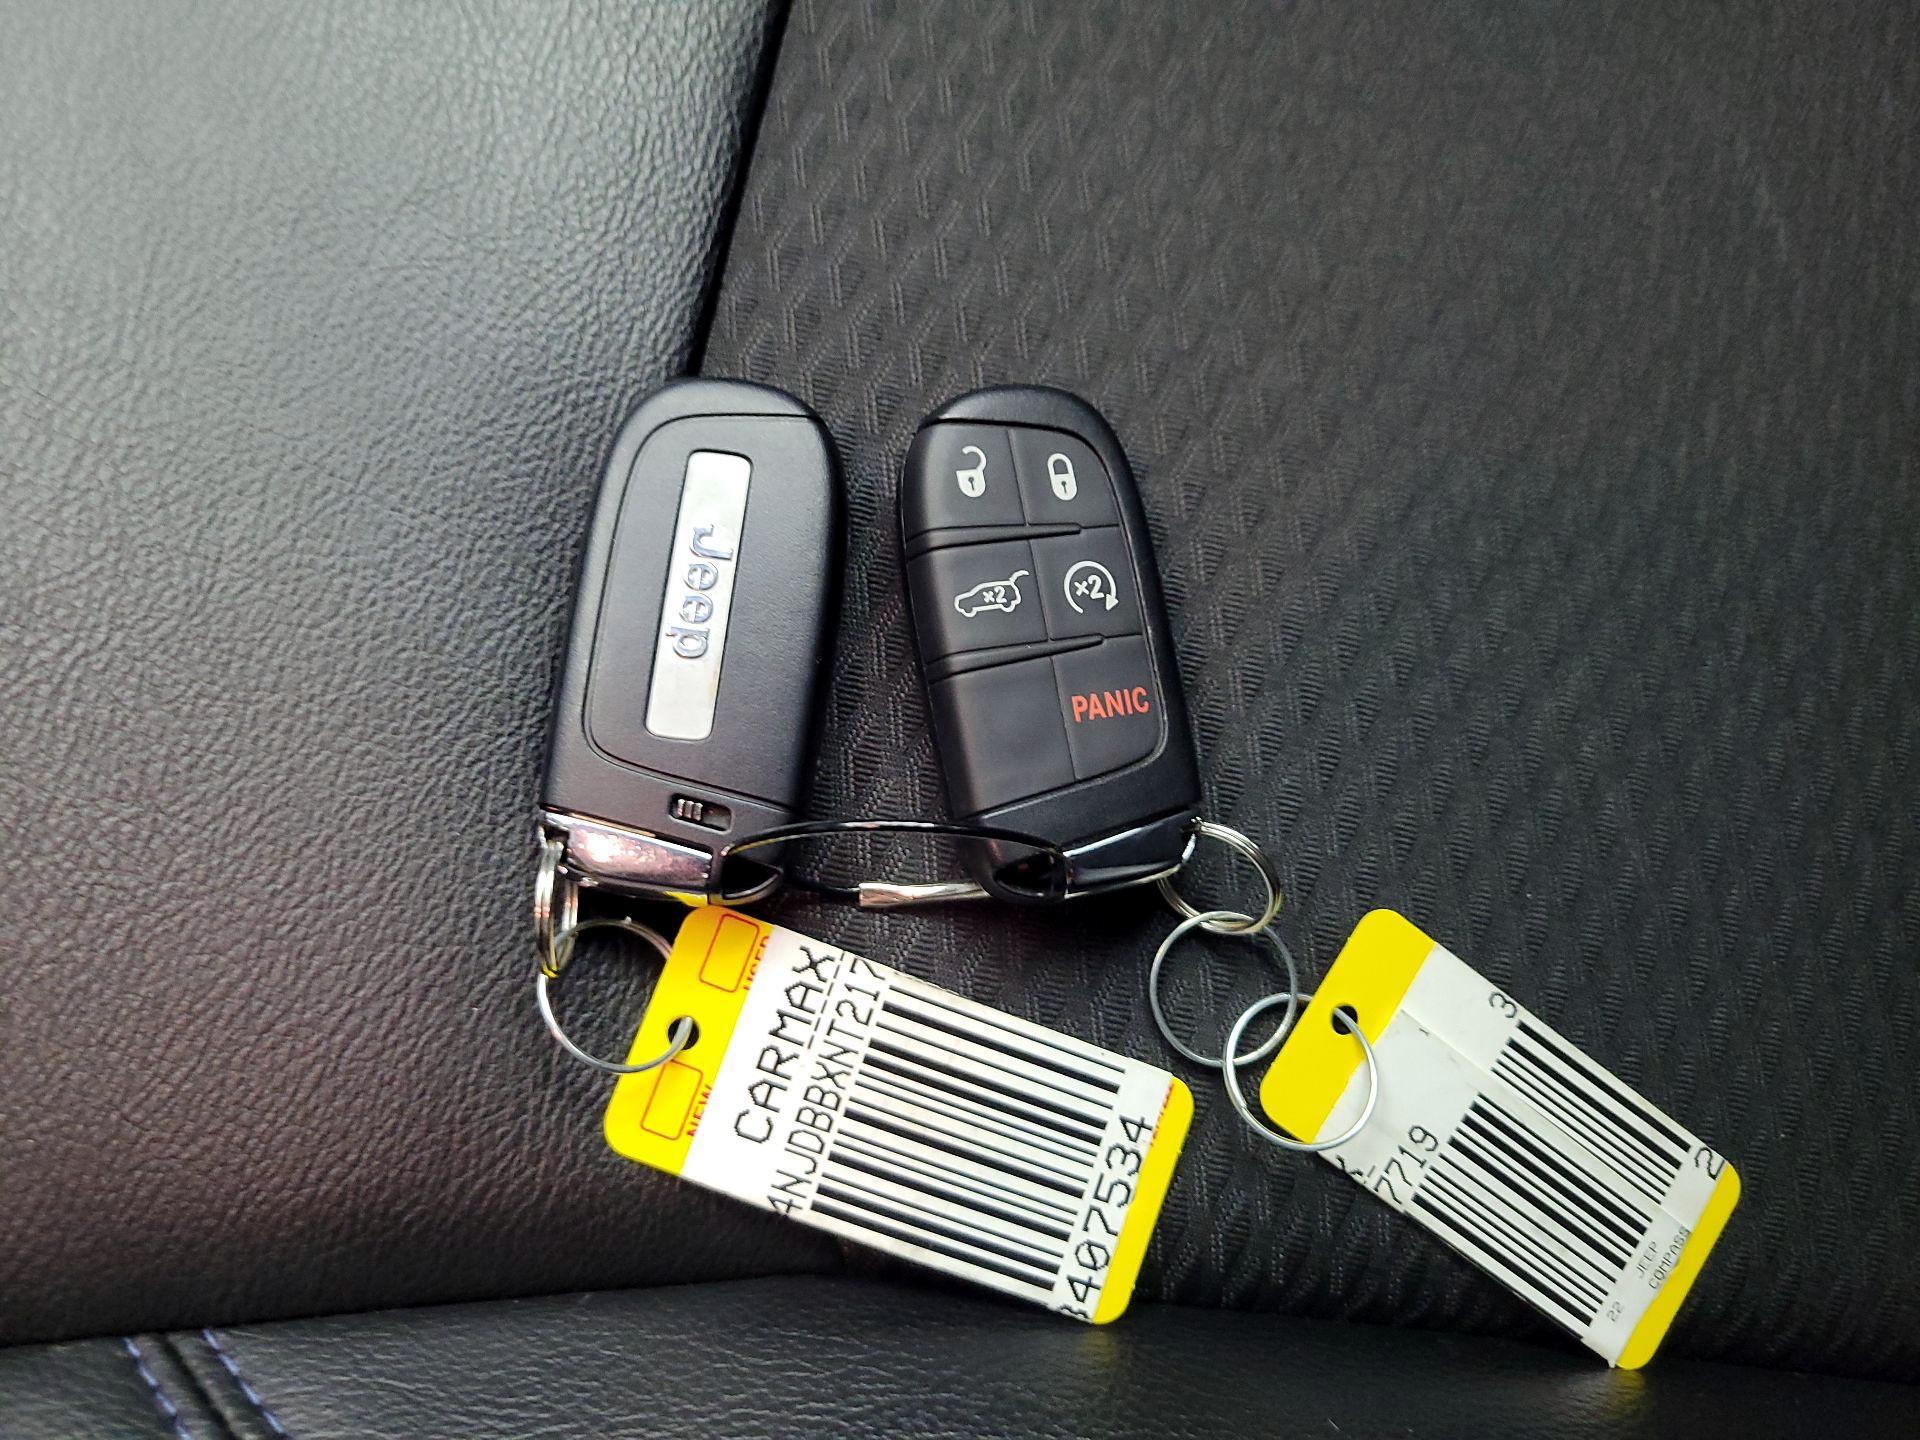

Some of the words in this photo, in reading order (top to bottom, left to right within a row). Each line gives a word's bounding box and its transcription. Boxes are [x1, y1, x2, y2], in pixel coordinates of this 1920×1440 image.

[666, 524, 733, 659] Jeep
[1072, 686, 1150, 722] PANIC
[1489, 991, 1518, 1019] 3
[734, 946, 835, 1143] CARMAX
[1374, 1125, 1439, 1205] 7719
[1694, 1147, 1726, 1180] 2
[1636, 1240, 1657, 1279] JEEP
[1648, 1226, 1693, 1290] COMPASS
